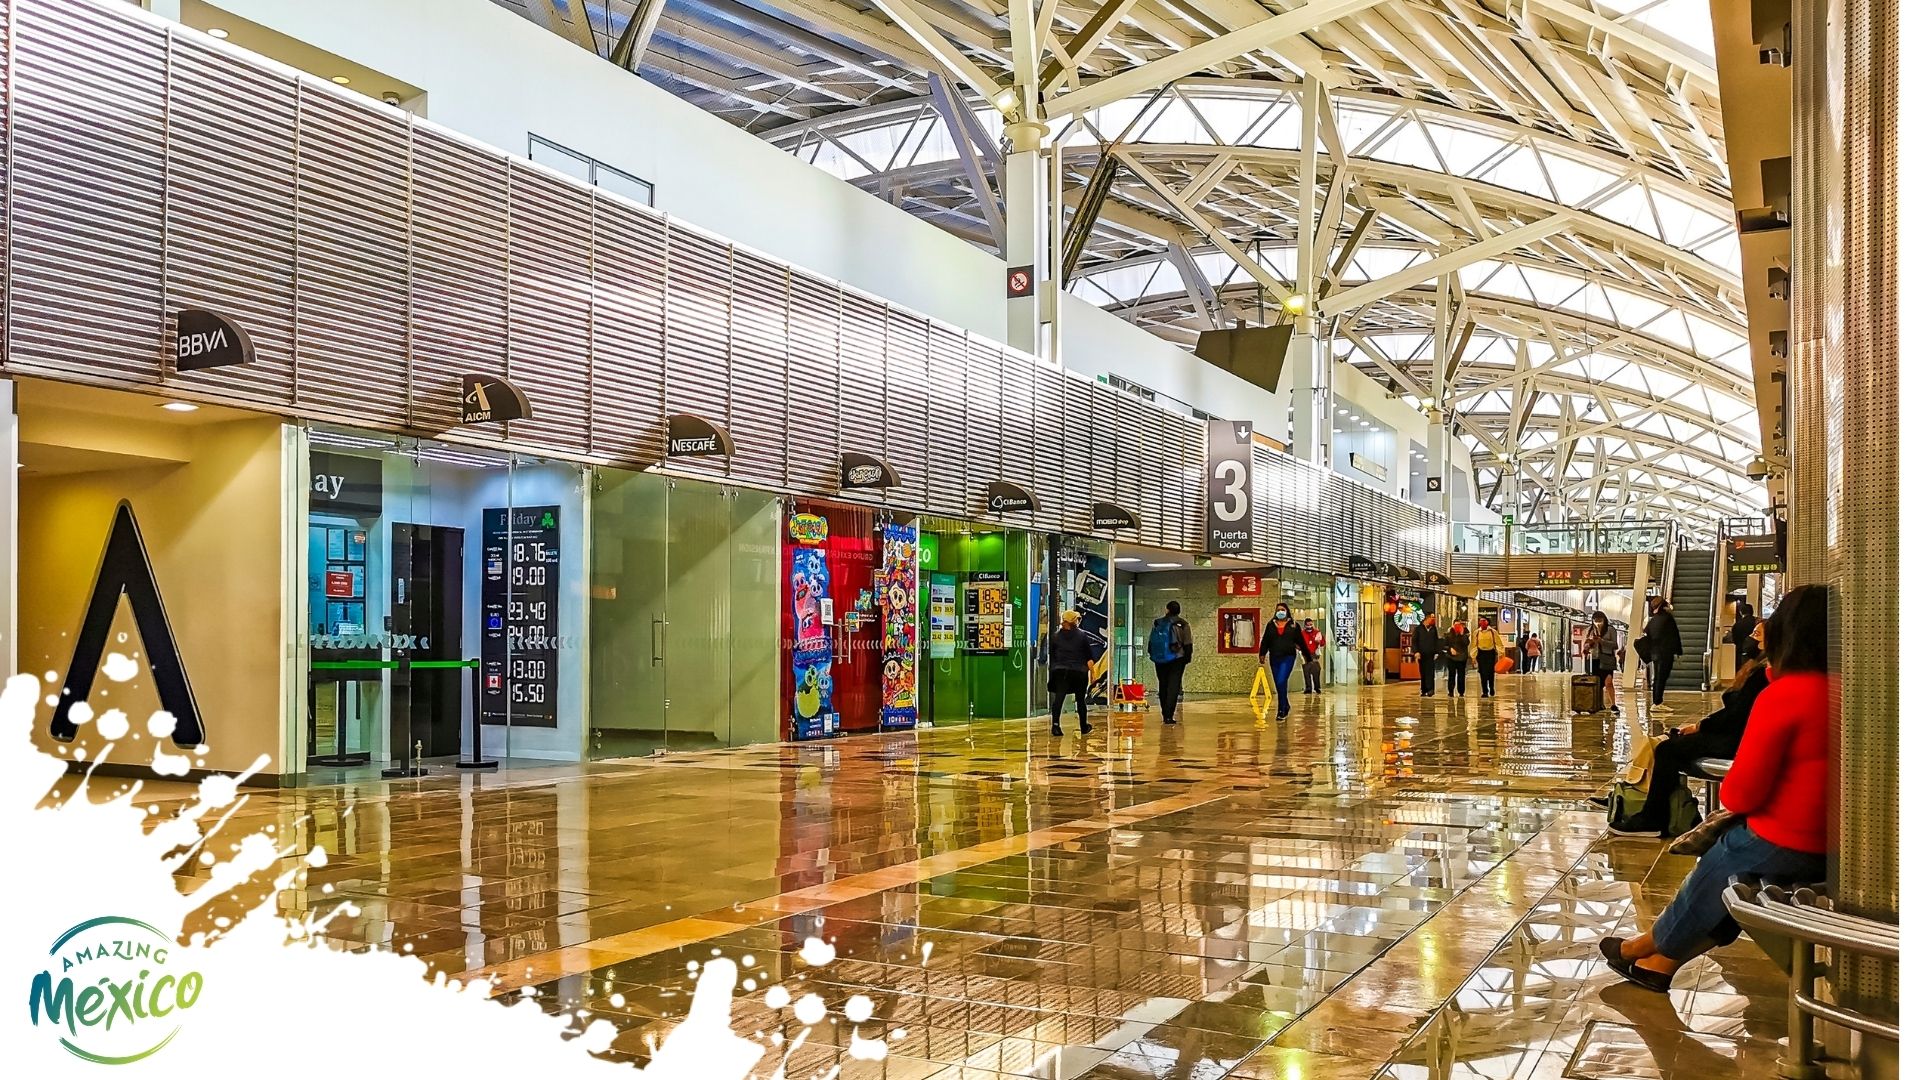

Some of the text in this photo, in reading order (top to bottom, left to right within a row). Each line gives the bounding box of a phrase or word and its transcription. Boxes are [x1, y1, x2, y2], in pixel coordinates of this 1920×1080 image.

[180, 328, 228, 357] BBVA
[465, 412, 491, 422] AICM
[1213, 460, 1248, 522] 3
[500, 512, 537, 527] Fiday
[1213, 530, 1248, 540] Puerta
[514, 543, 546, 562] 18.76
[1219, 541, 1241, 549] Door
[513, 567, 546, 585] 19.00
[513, 660, 546, 679] 13.00
[513, 684, 545, 702] 15.50
